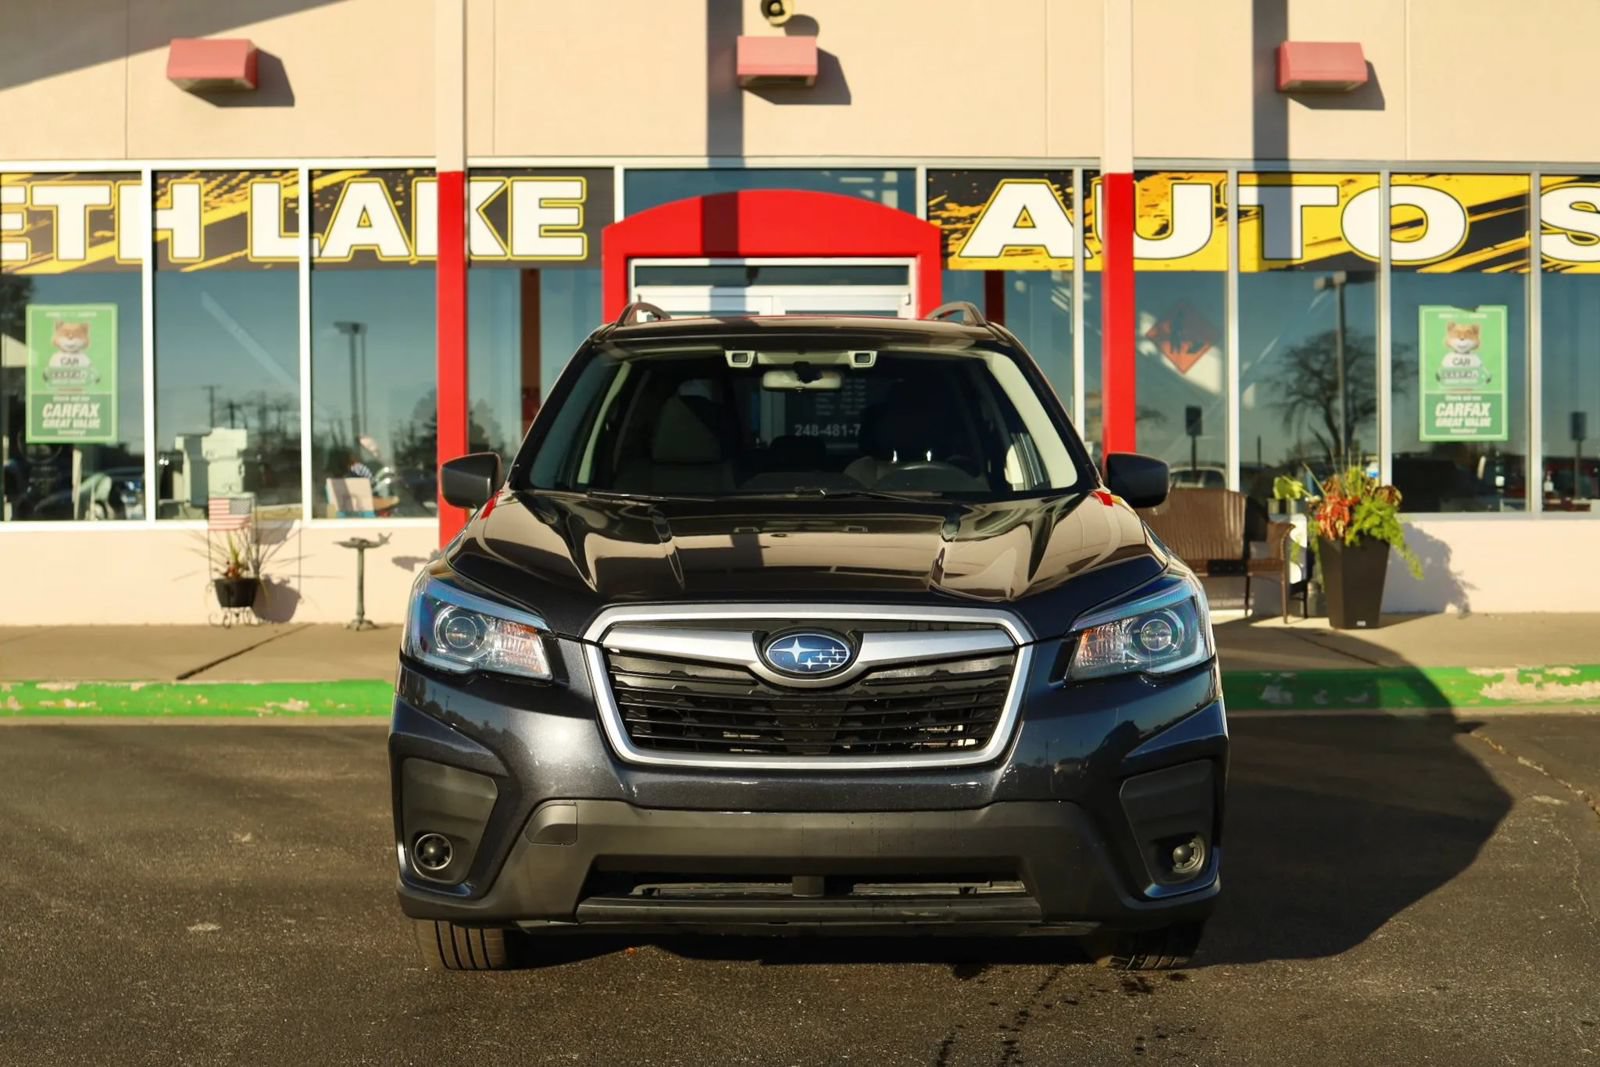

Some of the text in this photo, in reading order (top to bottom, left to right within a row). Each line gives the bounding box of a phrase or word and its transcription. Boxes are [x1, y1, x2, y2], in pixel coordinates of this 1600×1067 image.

[249, 179, 587, 260] LAKE
[957, 180, 1467, 263] AUTO
[42, 403, 100, 417] CARFAX
[1435, 402, 1491, 416] CARFAX
